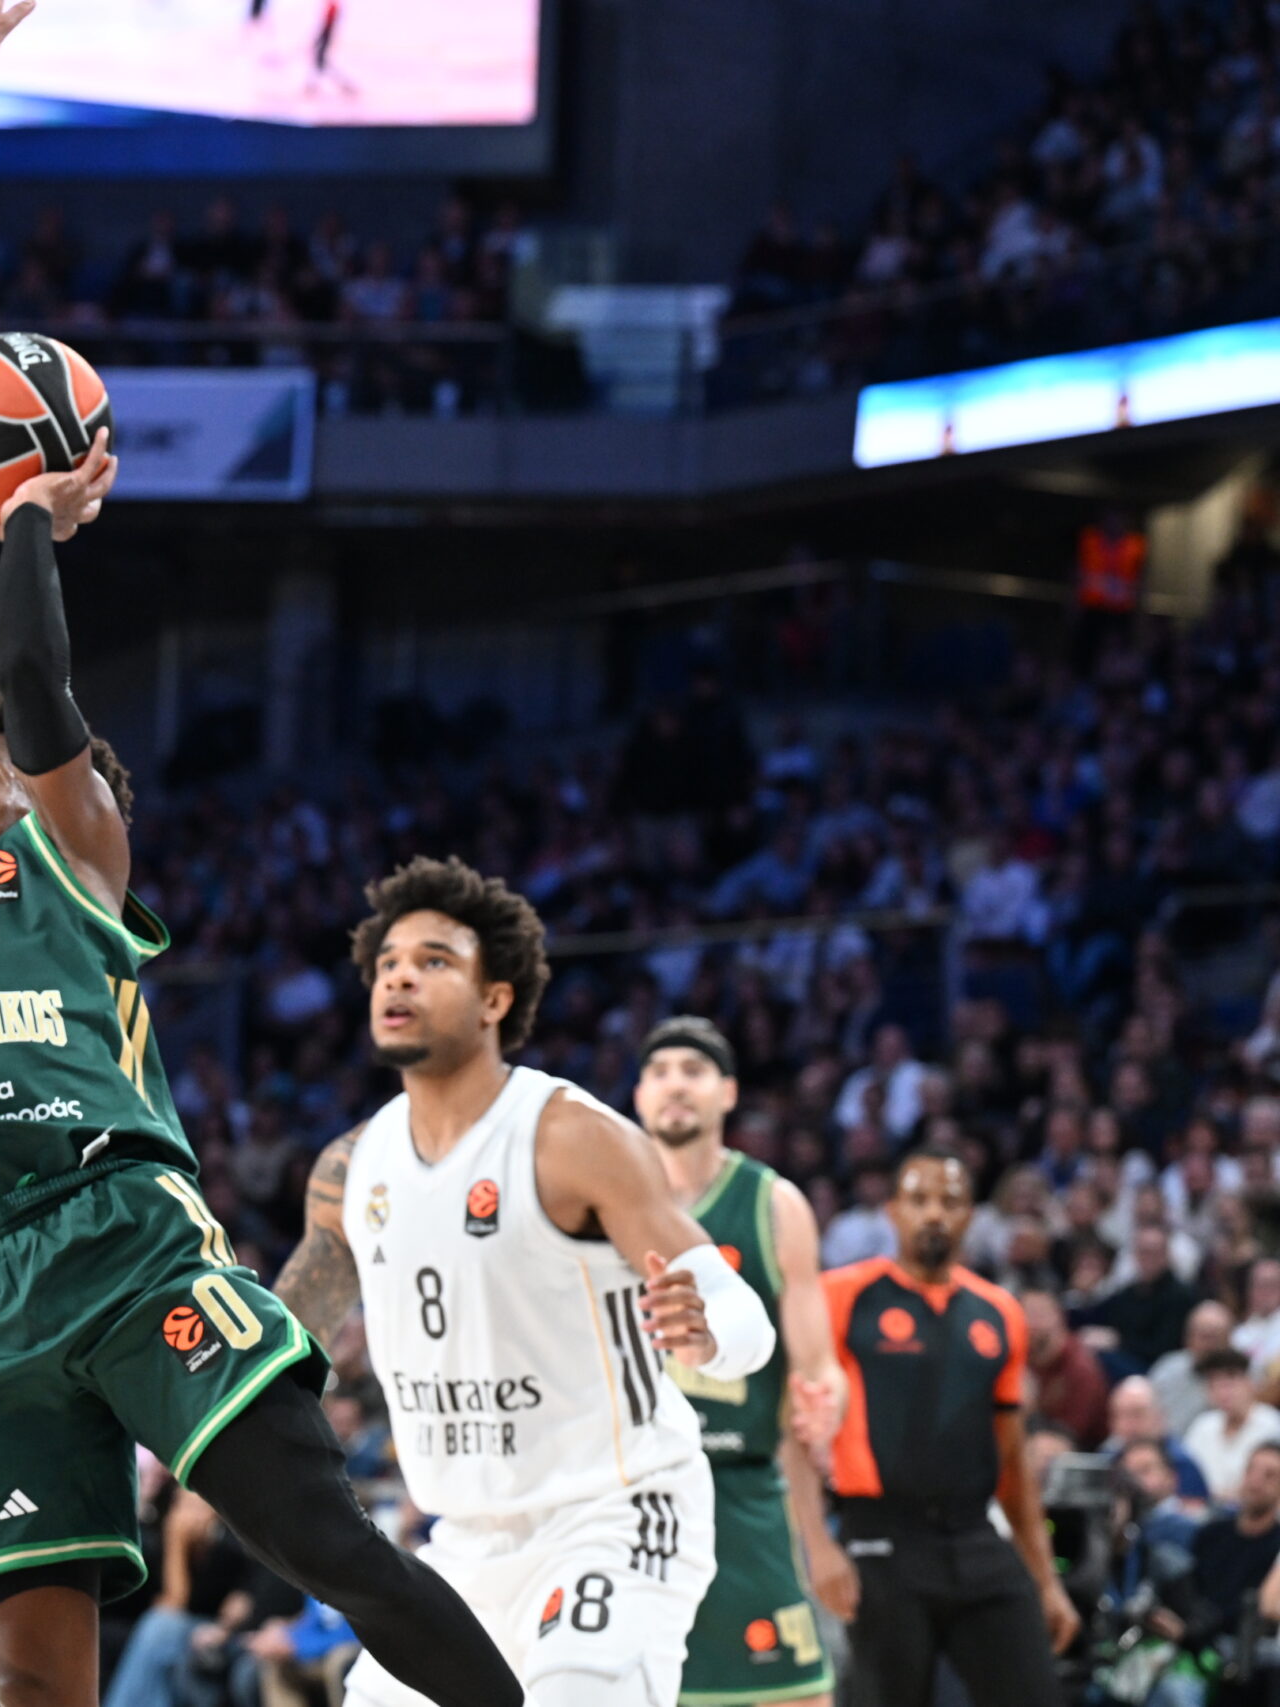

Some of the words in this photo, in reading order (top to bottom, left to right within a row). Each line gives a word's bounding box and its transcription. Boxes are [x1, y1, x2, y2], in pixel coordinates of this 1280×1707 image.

[191, 1273, 264, 1351] 0
[416, 1266, 447, 1340] 8
[393, 1371, 543, 1414] Emirates
[570, 1571, 614, 1632] 8
